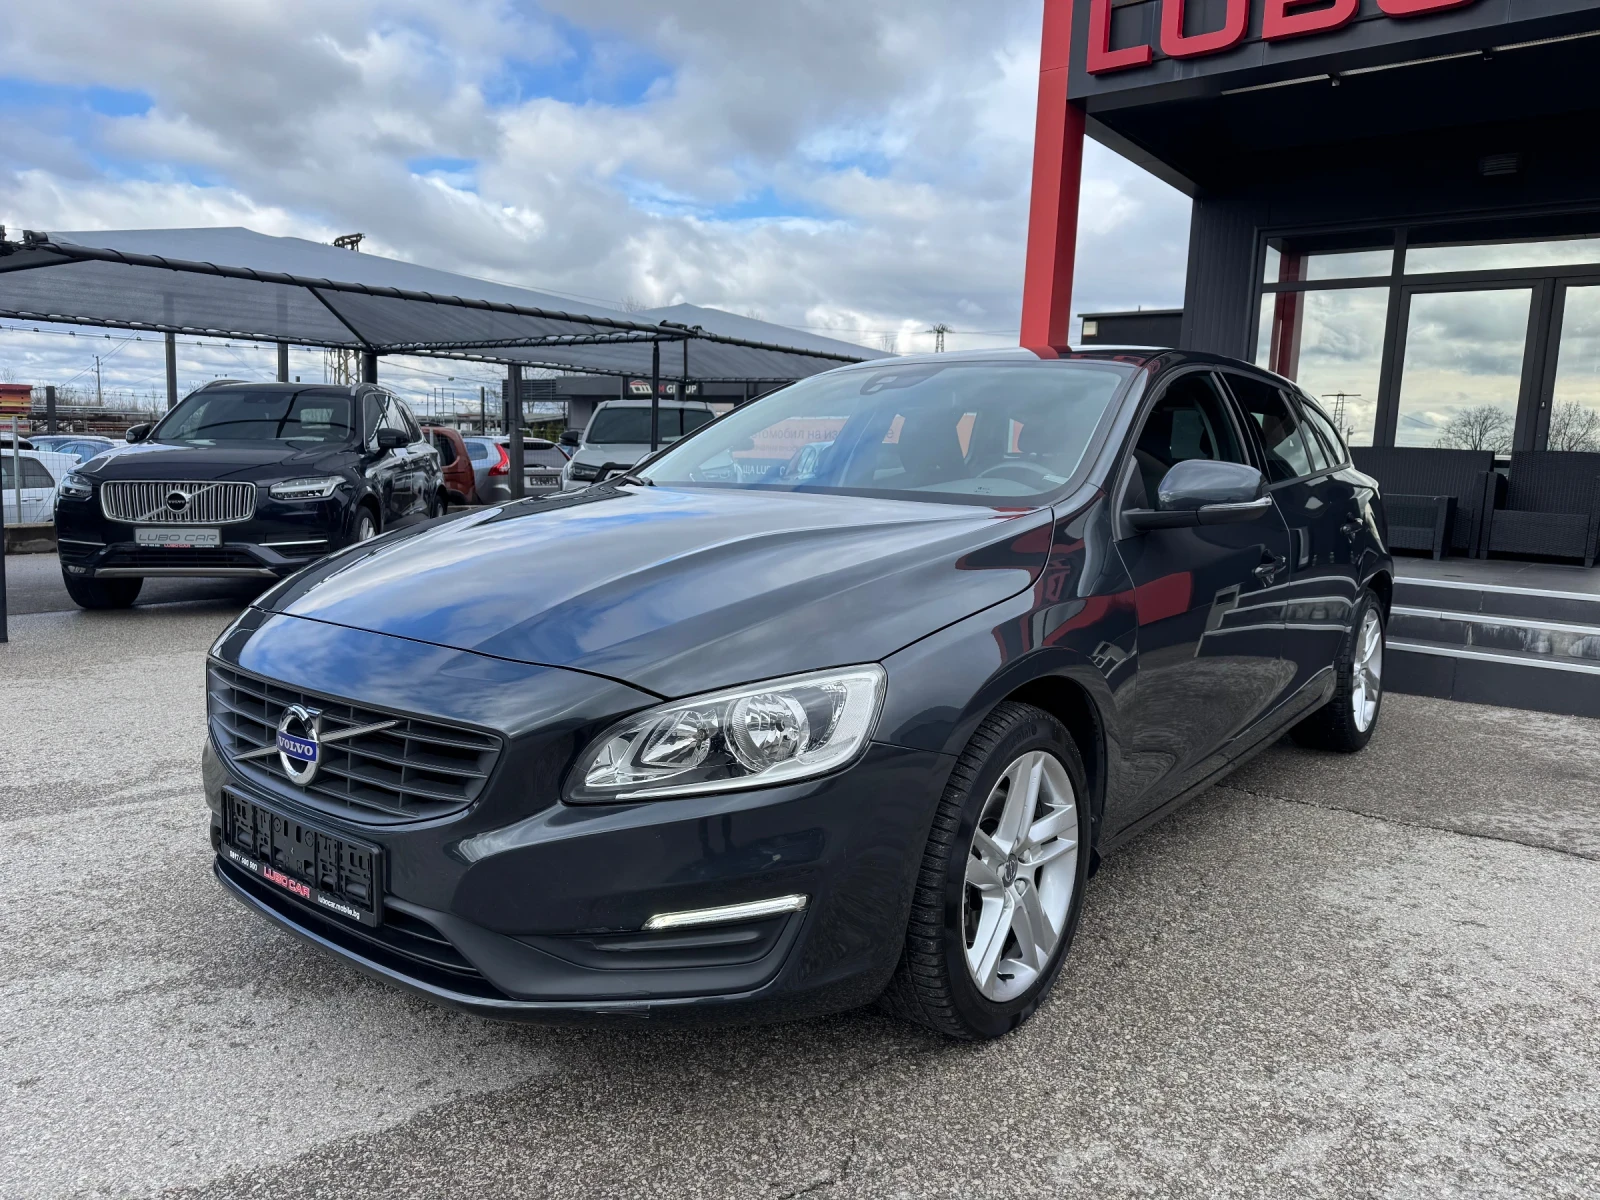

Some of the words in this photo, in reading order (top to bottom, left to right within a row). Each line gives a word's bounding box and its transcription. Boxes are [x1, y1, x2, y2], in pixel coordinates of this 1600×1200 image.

[139, 533, 181, 542] LUBO
[184, 534, 217, 542] CAR
[278, 736, 313, 756] VOLVO
[263, 866, 288, 887] LUBO
[288, 880, 310, 899] CAR
